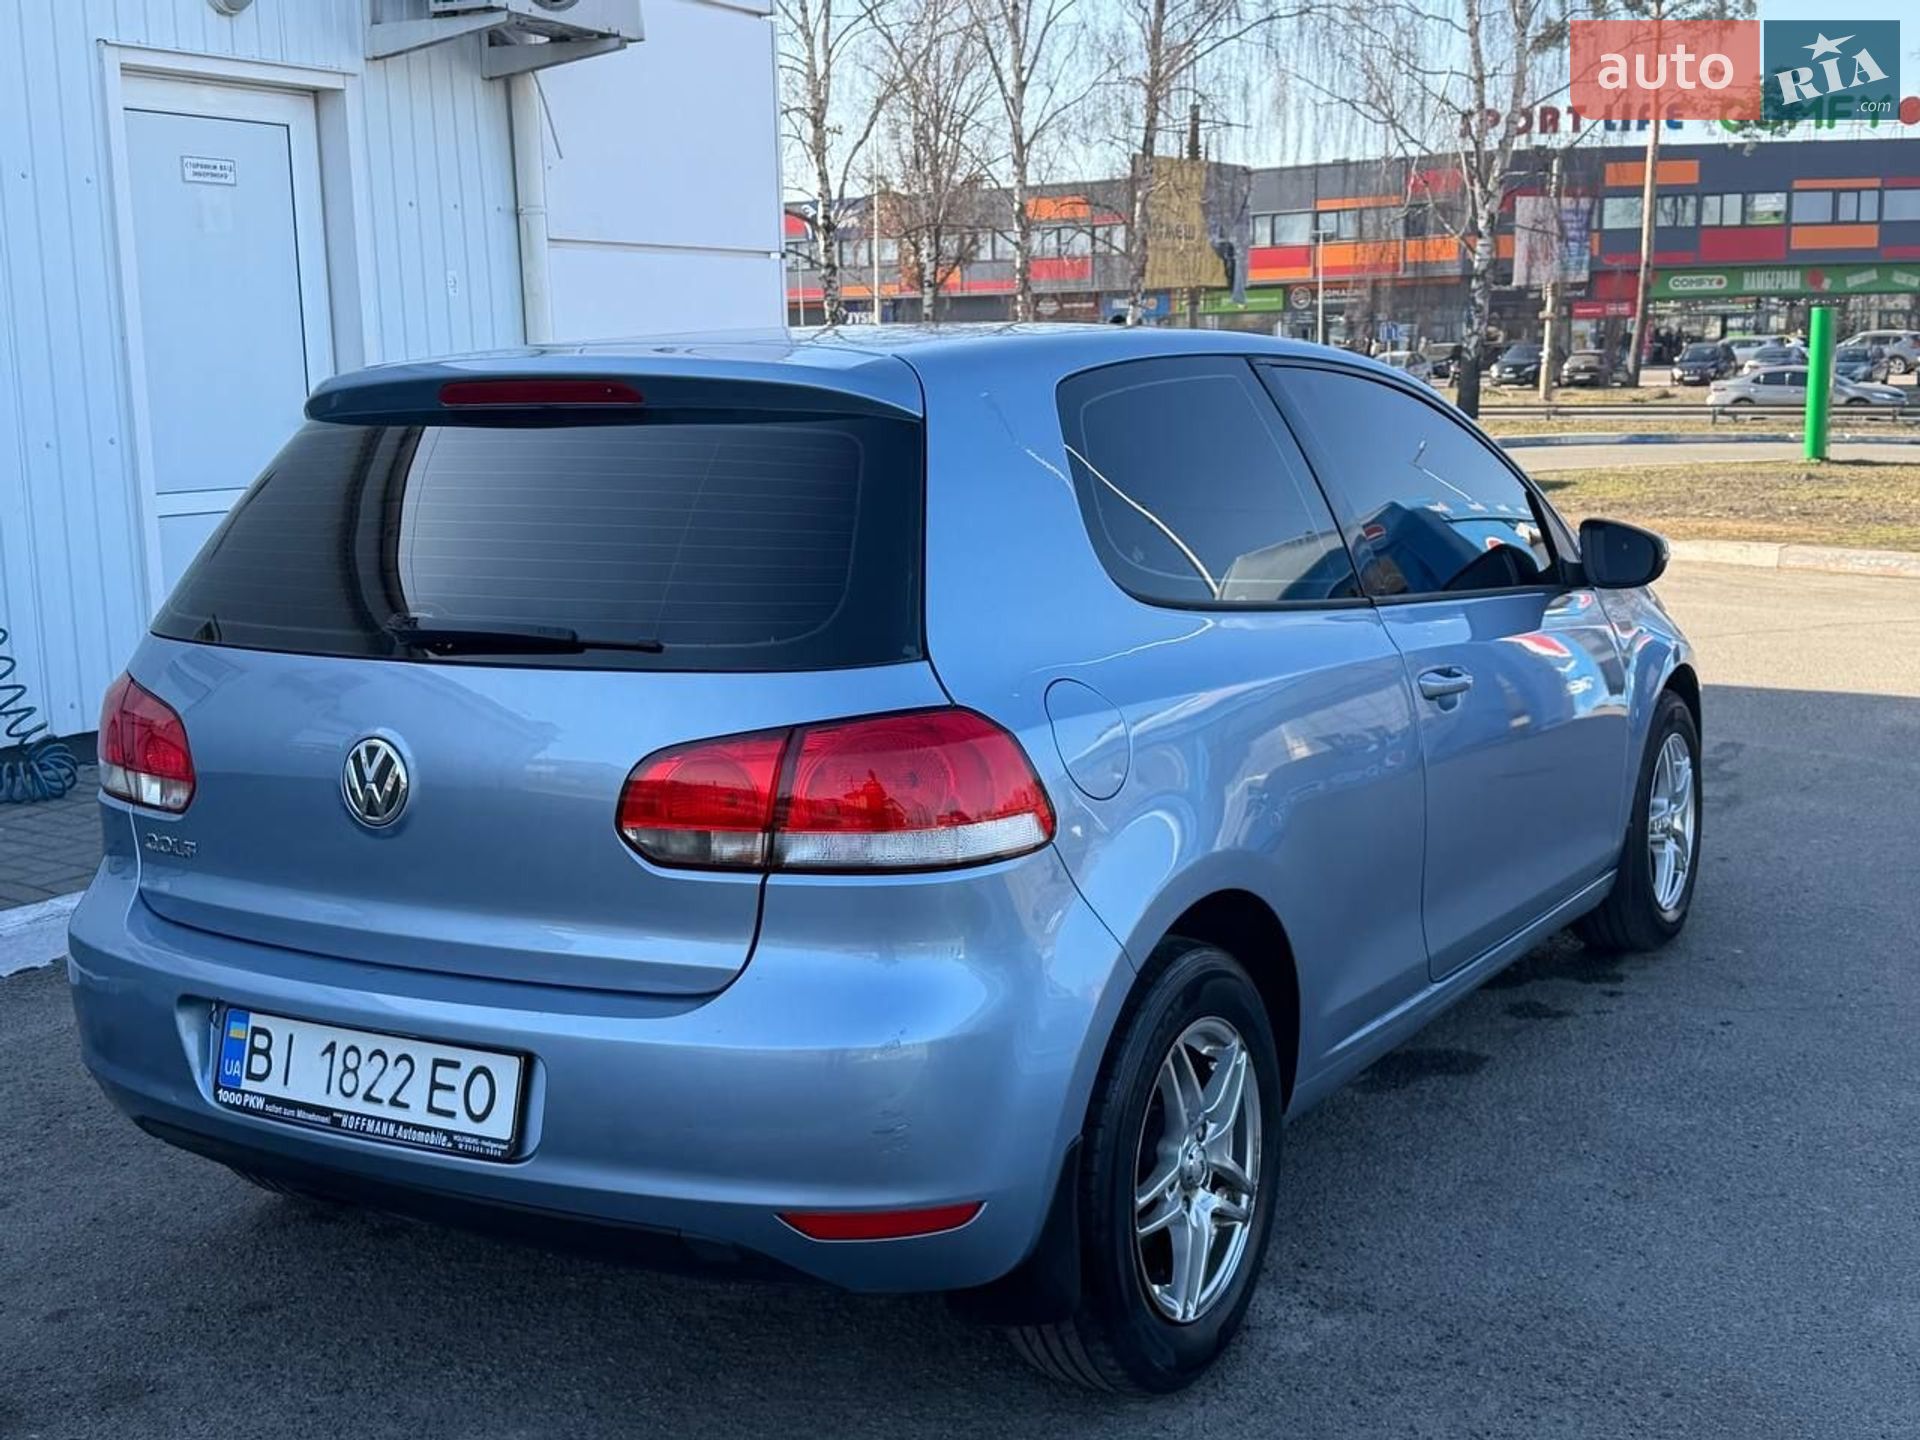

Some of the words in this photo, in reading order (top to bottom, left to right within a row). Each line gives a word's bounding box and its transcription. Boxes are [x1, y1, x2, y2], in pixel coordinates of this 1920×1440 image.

[1604, 103, 1684, 132] LIFE
[145, 832, 196, 857] GOLF
[224, 1058, 241, 1077] UA
[320, 1040, 415, 1110] 1822
[218, 1088, 242, 1106] 1000
[243, 1093, 266, 1111] PKW
